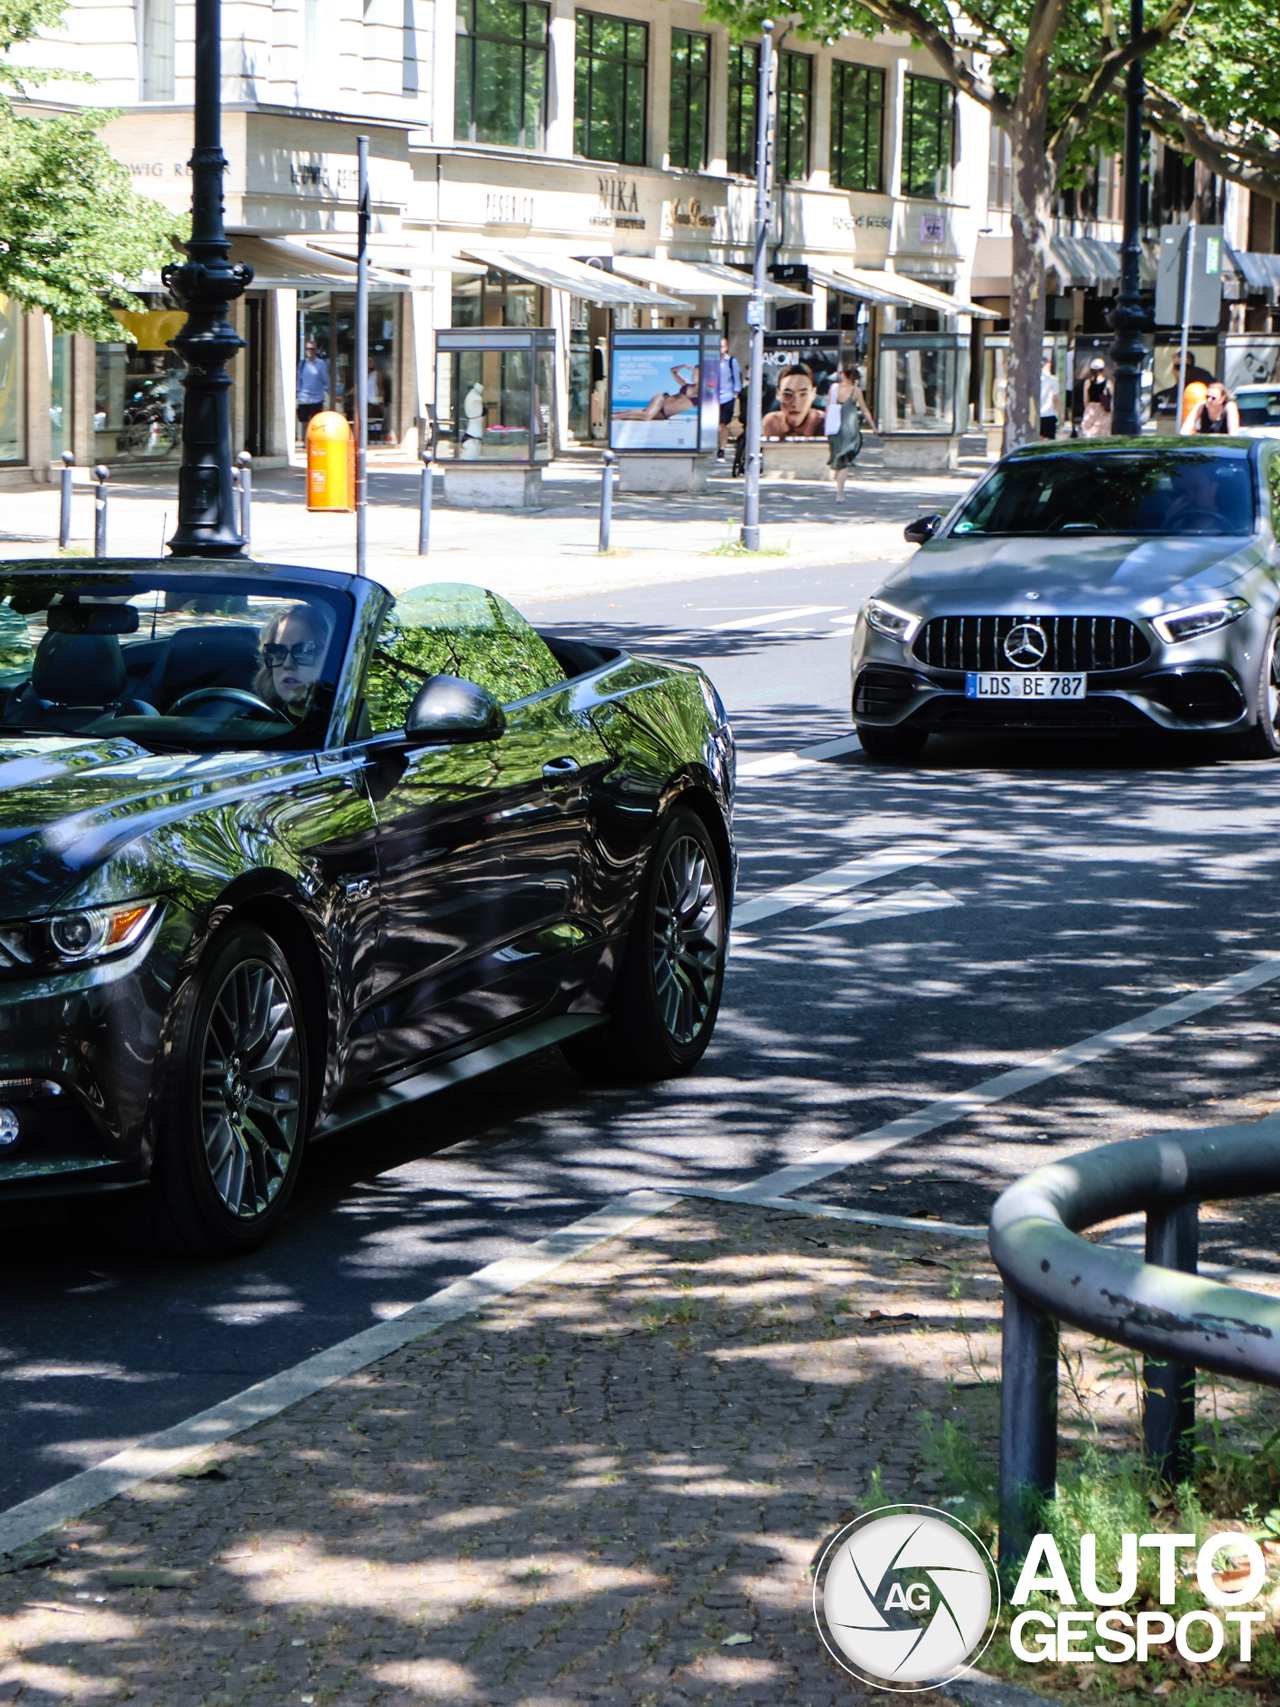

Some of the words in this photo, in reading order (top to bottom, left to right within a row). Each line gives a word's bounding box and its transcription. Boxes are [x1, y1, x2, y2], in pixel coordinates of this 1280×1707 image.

[598, 177, 639, 213] NIKA
[978, 677, 1011, 696] LDS
[1023, 677, 1045, 696] BE
[1050, 677, 1082, 696] 787
